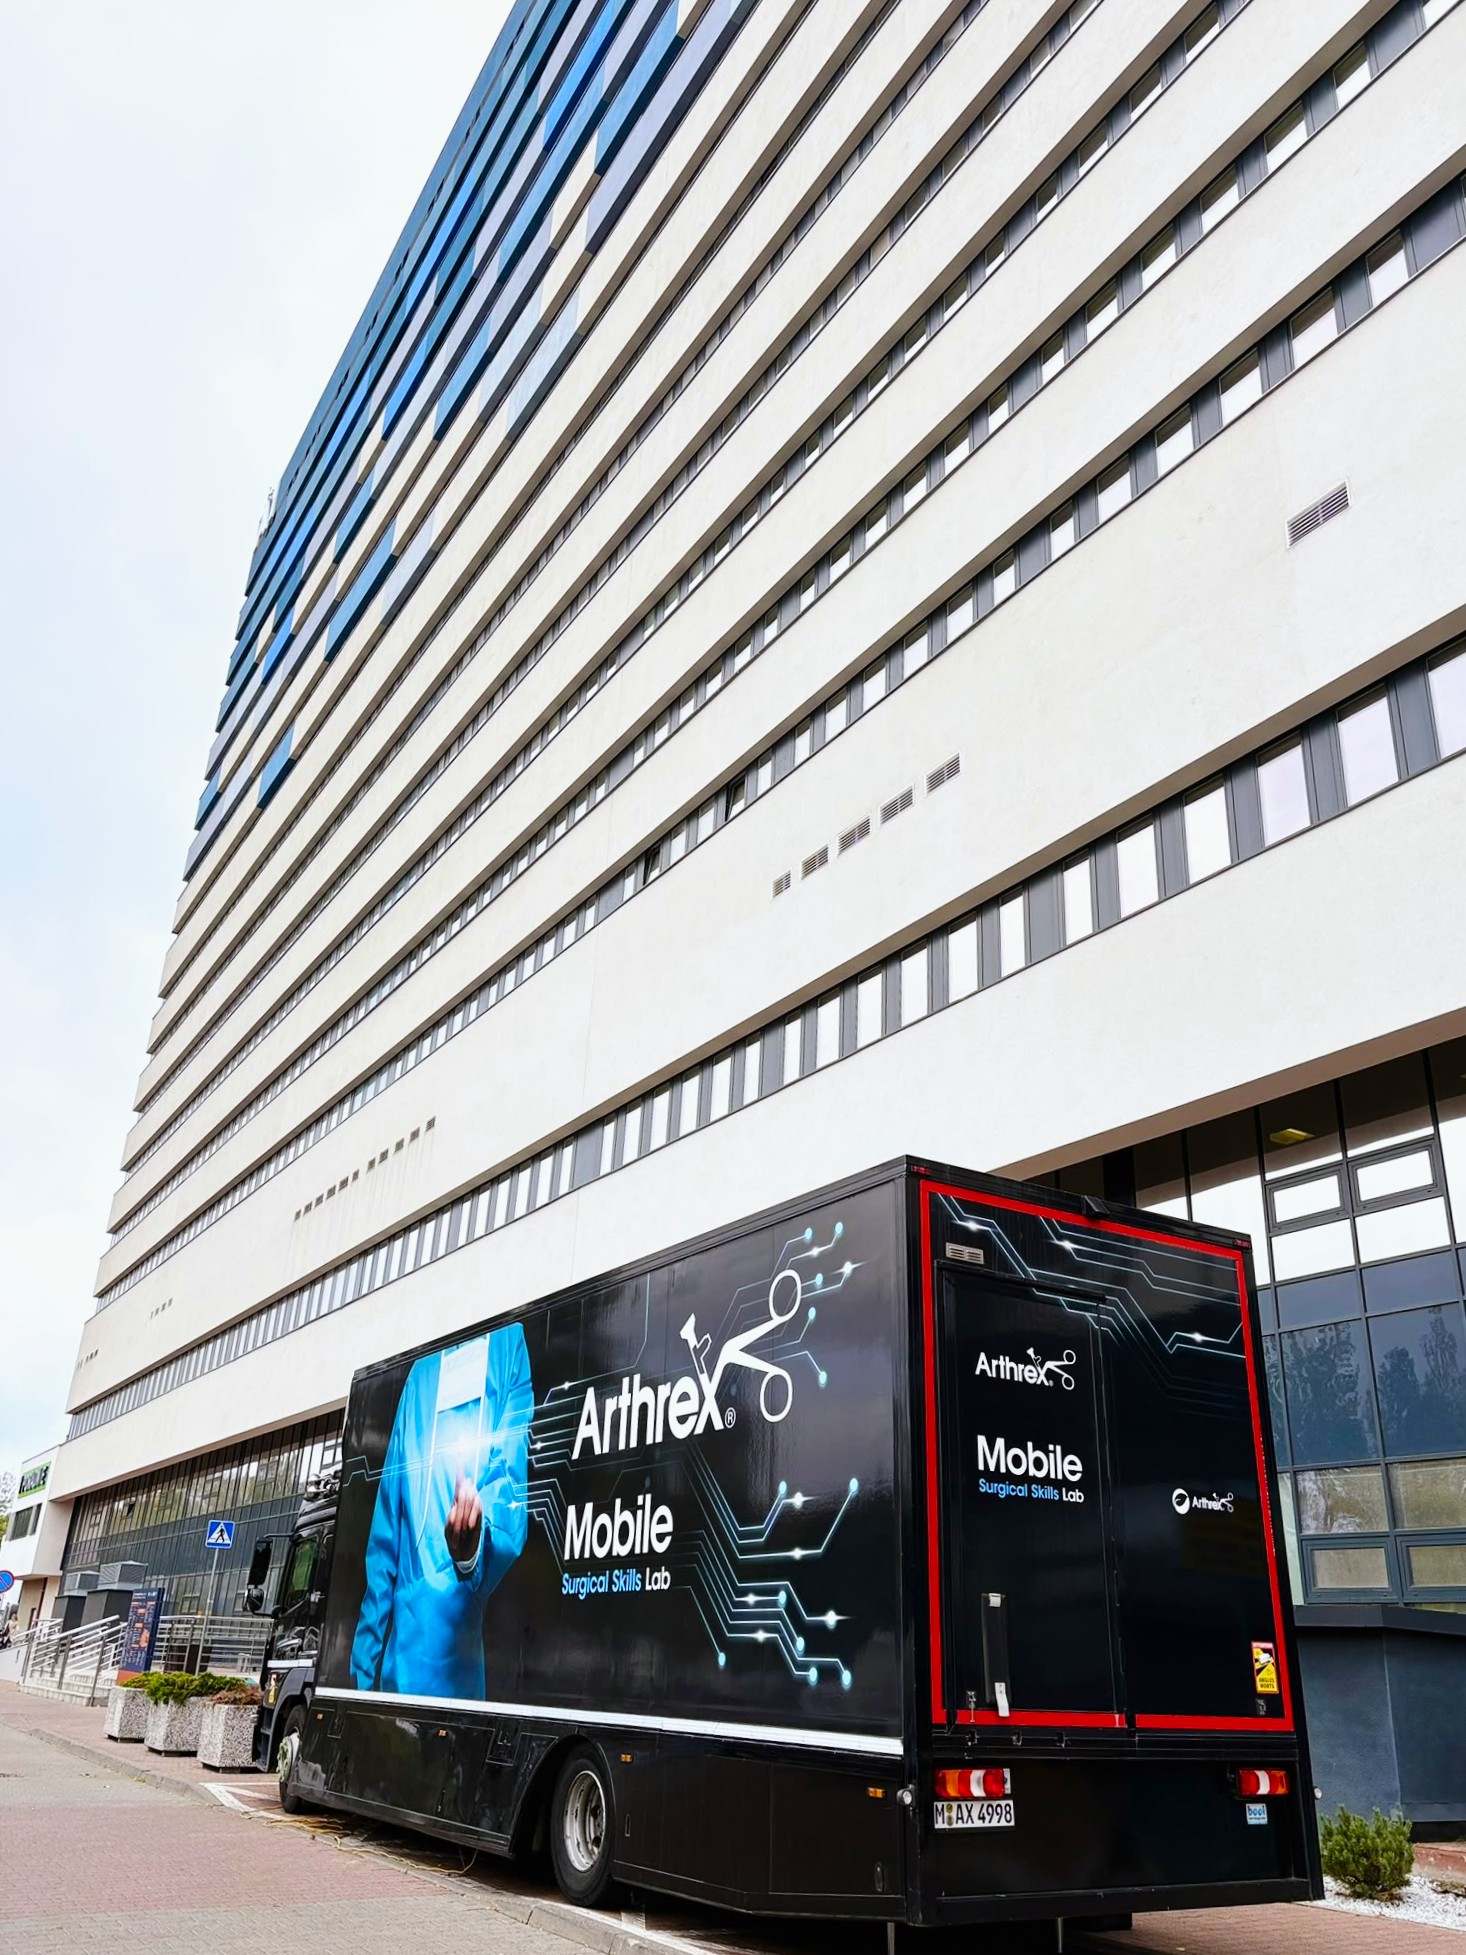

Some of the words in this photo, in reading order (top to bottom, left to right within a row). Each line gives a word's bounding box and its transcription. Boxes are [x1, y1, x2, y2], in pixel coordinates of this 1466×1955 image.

[977, 1434, 1083, 1482] Mobile
[979, 1478, 1028, 1499] Surgical
[1031, 1484, 1060, 1501] Skills
[1062, 1487, 1085, 1503] Lab
[564, 1493, 674, 1560] Mobile
[561, 1570, 610, 1600] Surgical
[611, 1568, 642, 1592] Skills
[645, 1565, 671, 1591] Lab
[935, 1803, 945, 1825] M
[955, 1803, 974, 1824] AX
[977, 1802, 1013, 1824] 4998
